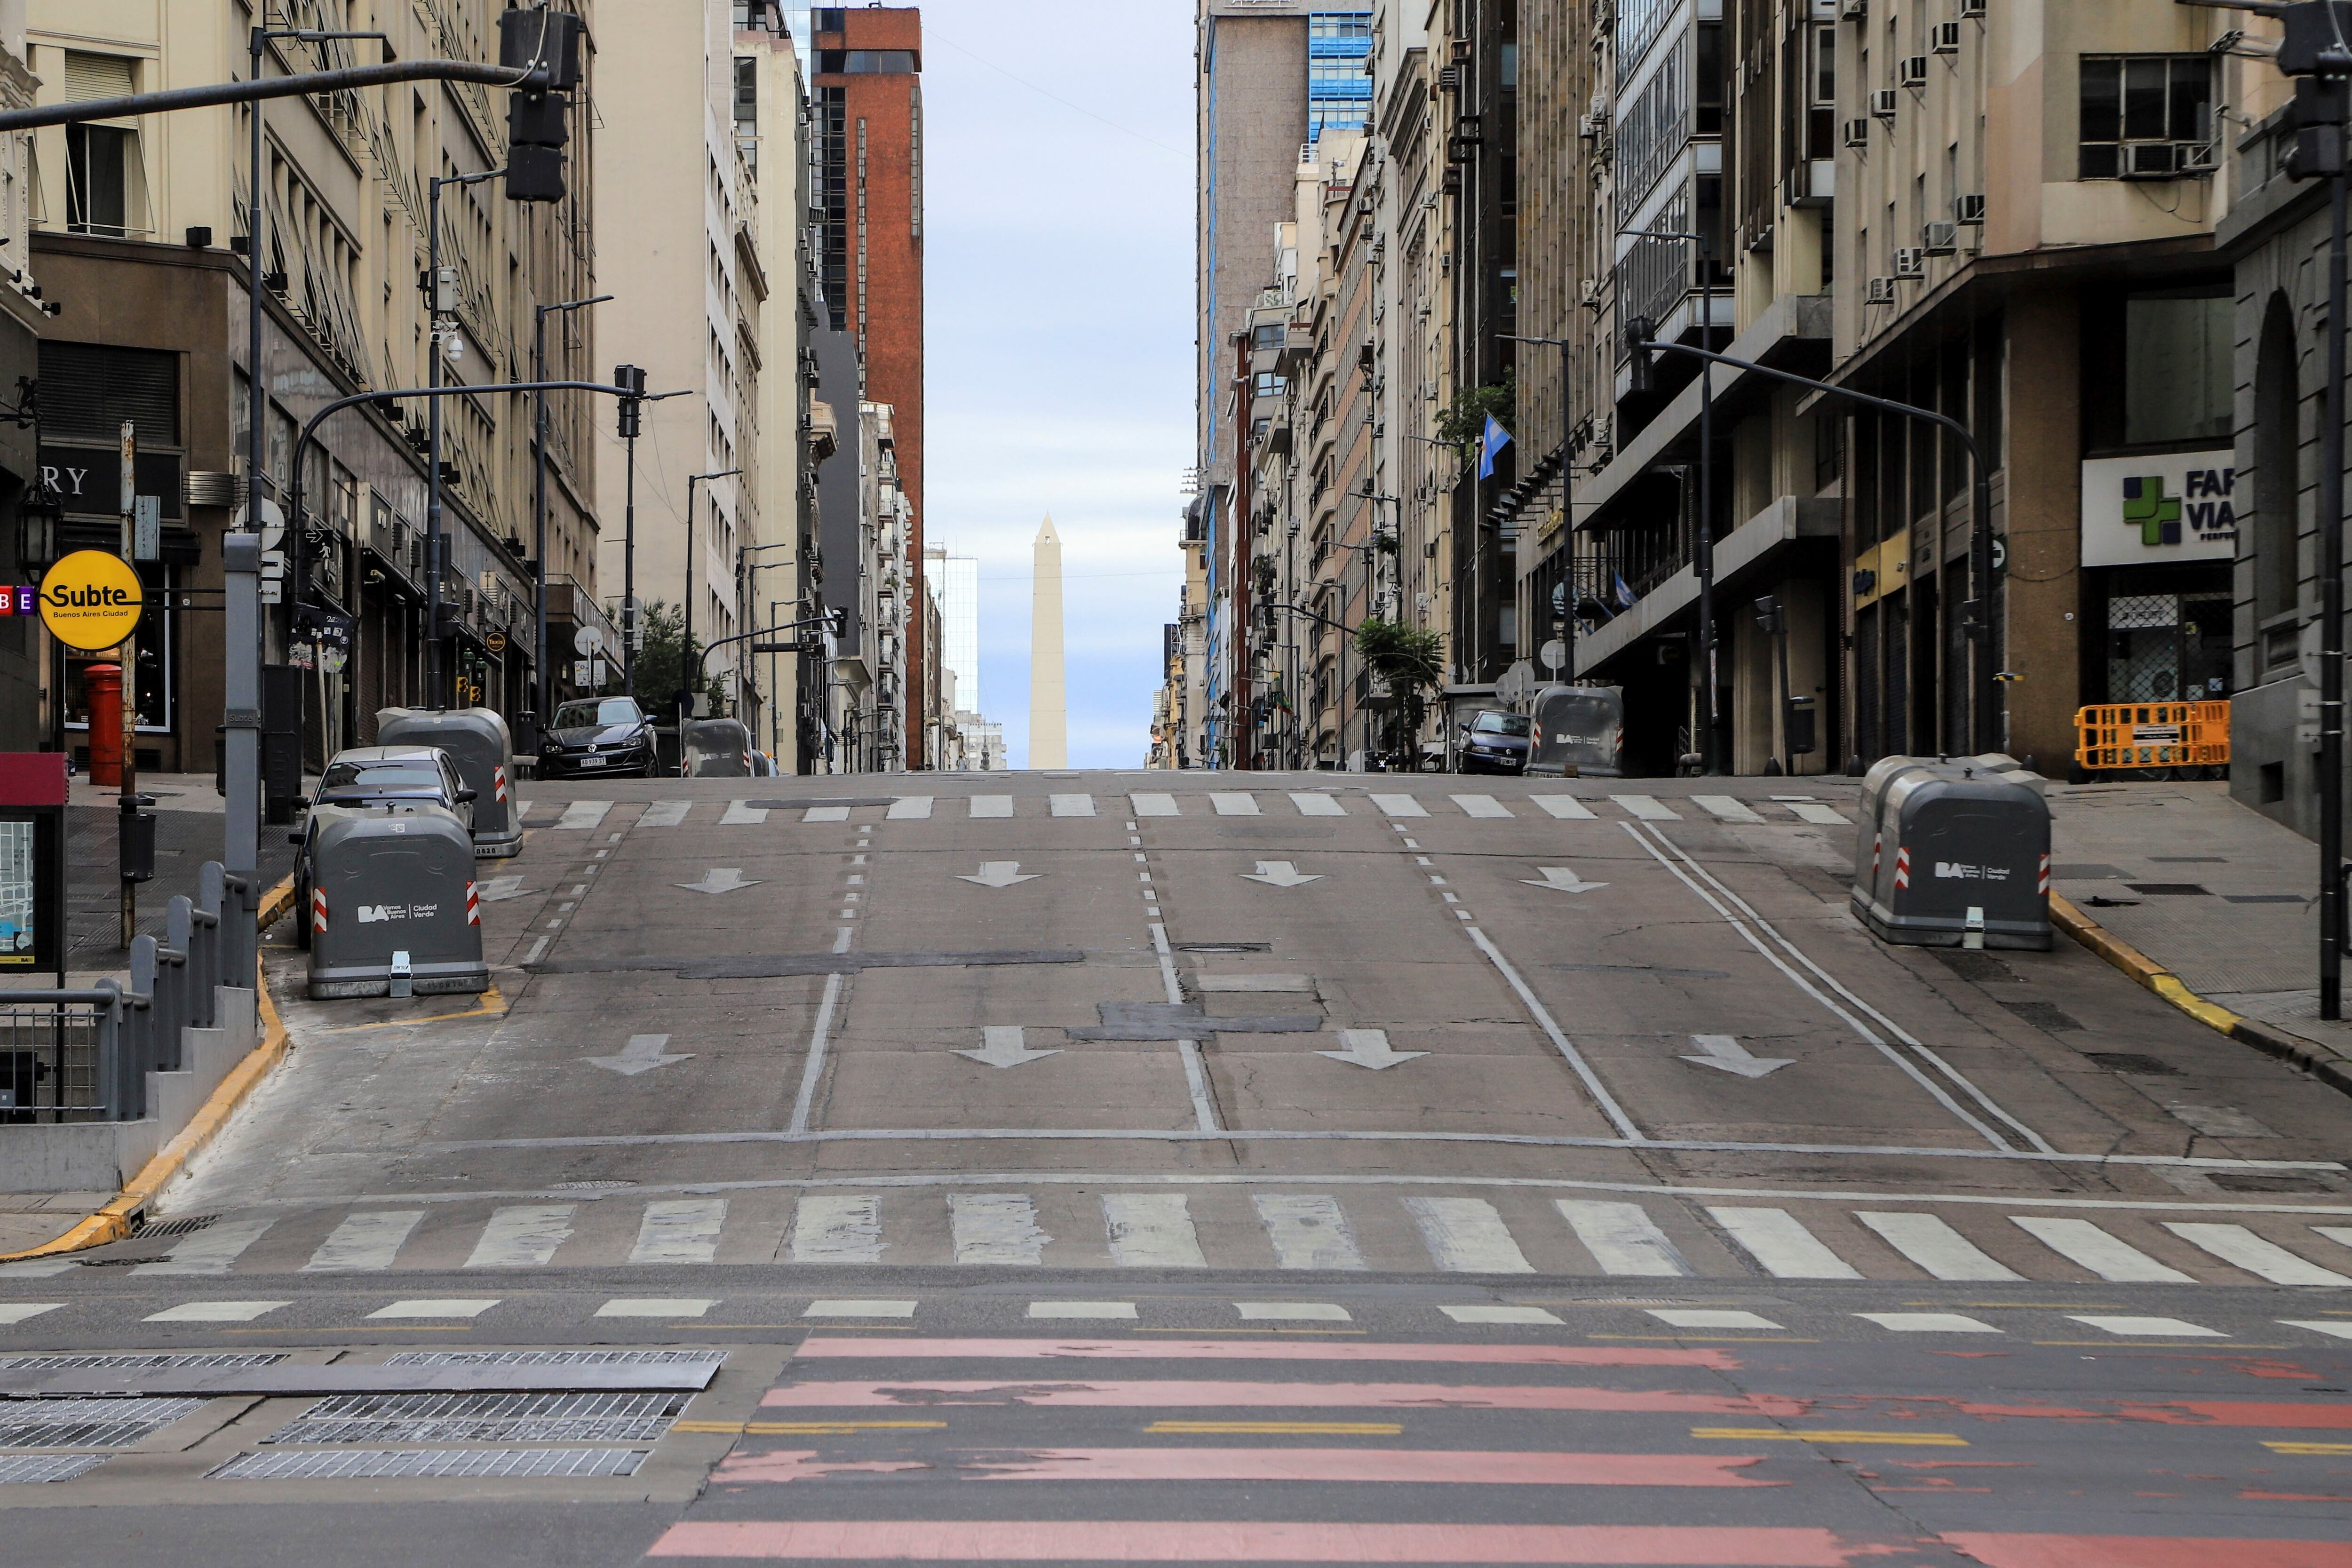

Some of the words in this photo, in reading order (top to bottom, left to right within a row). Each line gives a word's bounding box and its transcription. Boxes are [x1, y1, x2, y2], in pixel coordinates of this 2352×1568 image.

[2186, 501, 2235, 530] VIA
[21, 594, 31, 609] E
[53, 584, 129, 607] Subte
[1935, 862, 1964, 879] BA
[358, 904, 389, 923] BA
[413, 903, 437, 912] Ciudad
